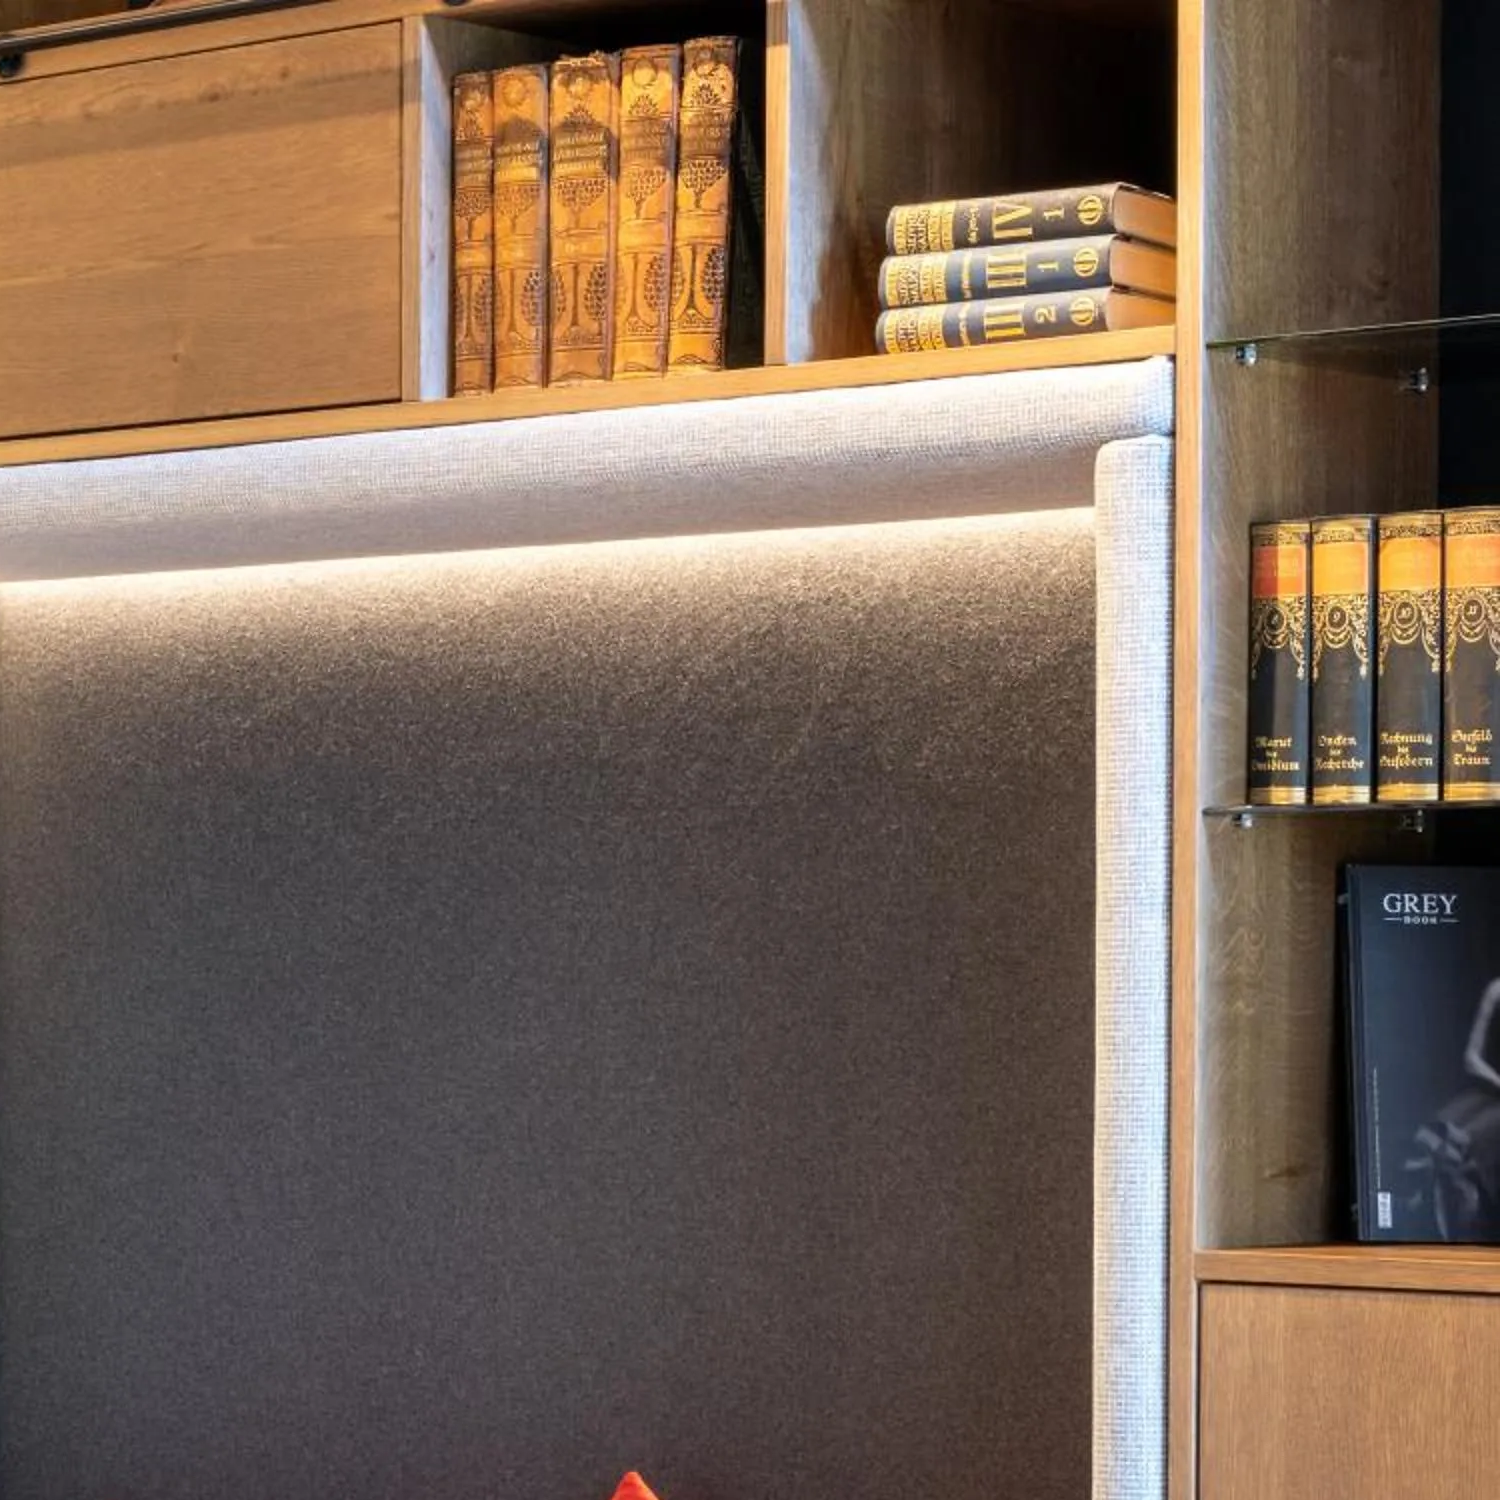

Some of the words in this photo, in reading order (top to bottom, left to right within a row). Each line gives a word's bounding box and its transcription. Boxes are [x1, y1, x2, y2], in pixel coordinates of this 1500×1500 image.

[993, 203, 1033, 240] IV
[1044, 207, 1065, 221] 1
[1035, 306, 1056, 323] 2
[1383, 893, 1457, 915] GREY
